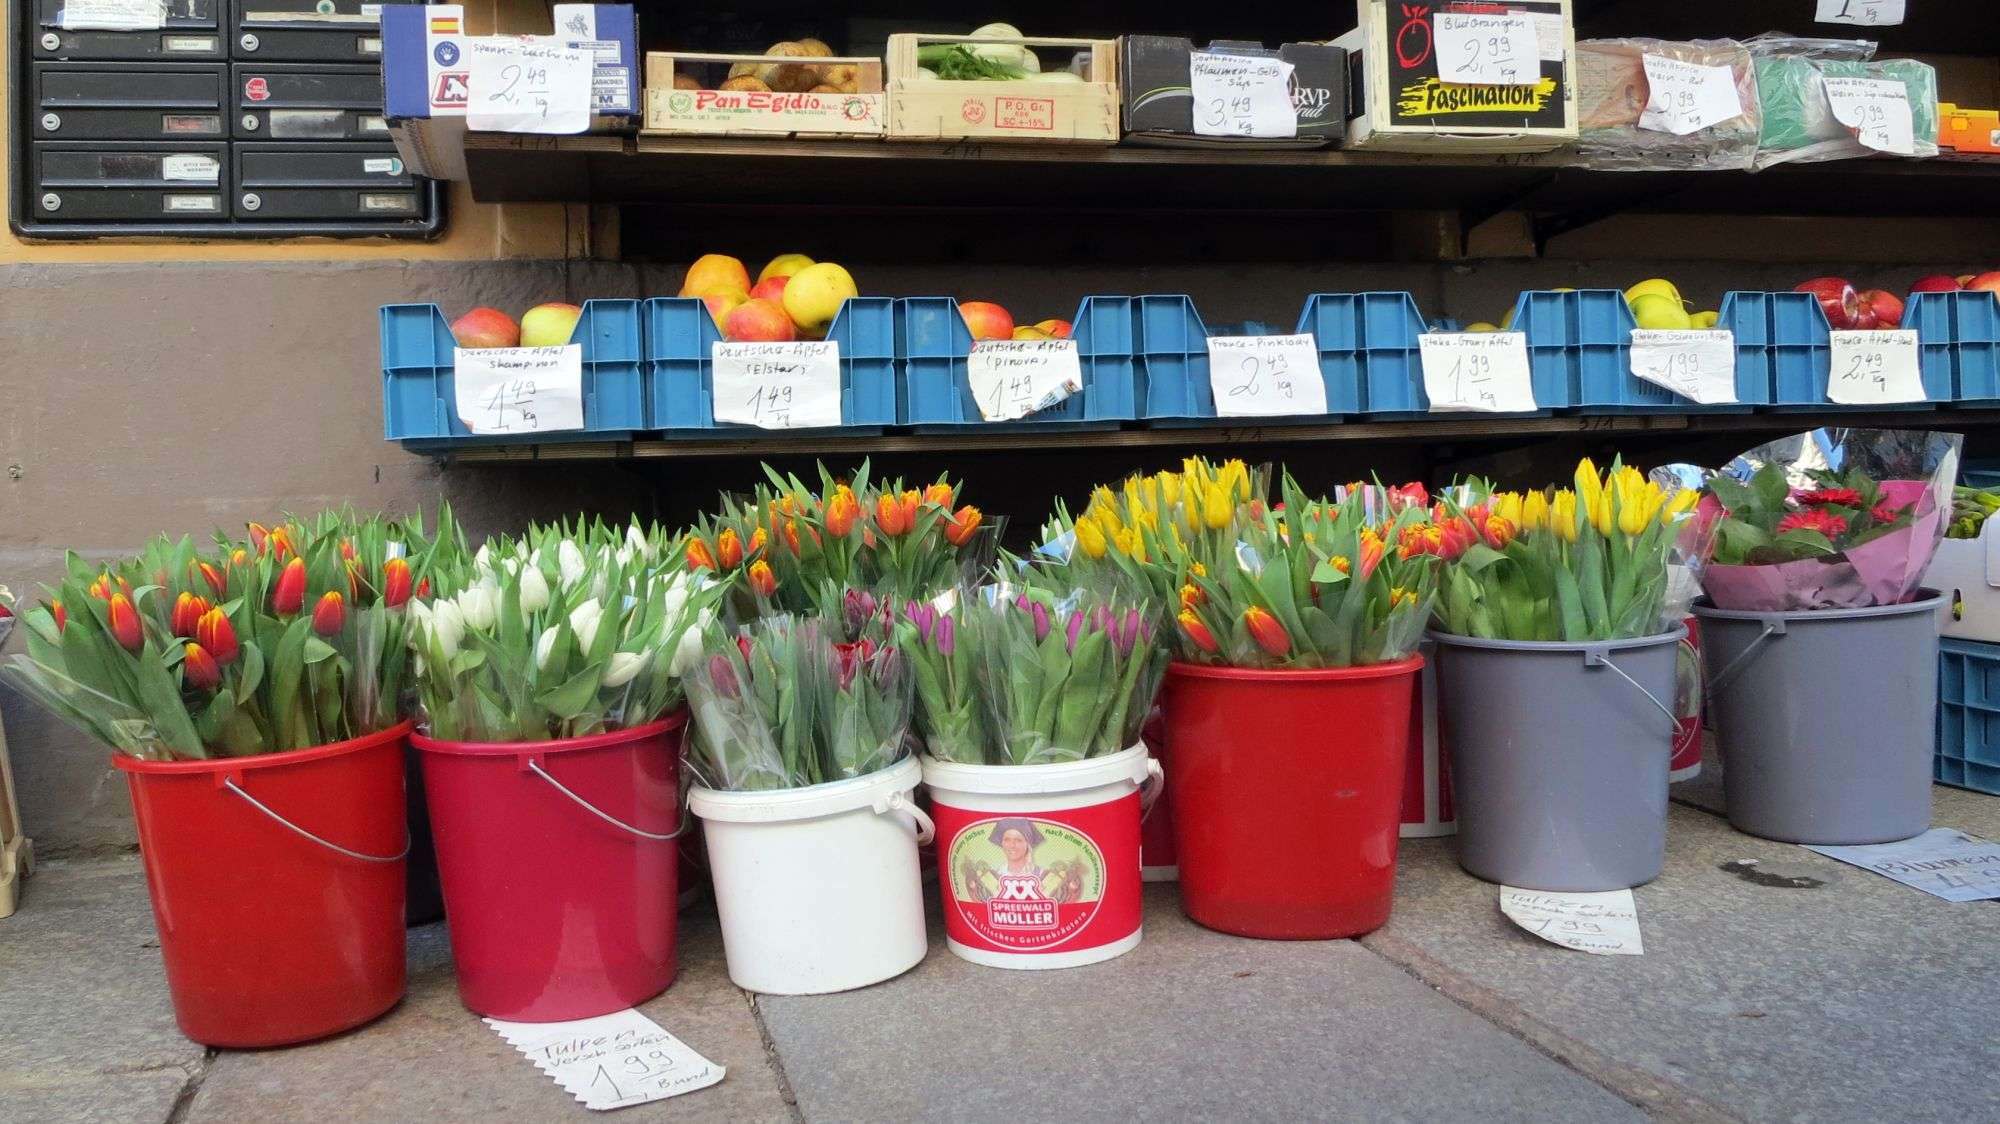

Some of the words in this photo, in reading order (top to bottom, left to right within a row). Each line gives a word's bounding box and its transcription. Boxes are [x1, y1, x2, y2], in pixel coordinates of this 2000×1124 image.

[696, 91, 740, 110] Pan
[747, 92, 821, 112] Egidio
[1426, 84, 1535, 111] Fascination
[1238, 121, 1254, 135] kg
[523, 409, 538, 429] kg
[992, 903, 1052, 912] SPREEWALD
[993, 911, 1053, 924] MÜLLER
